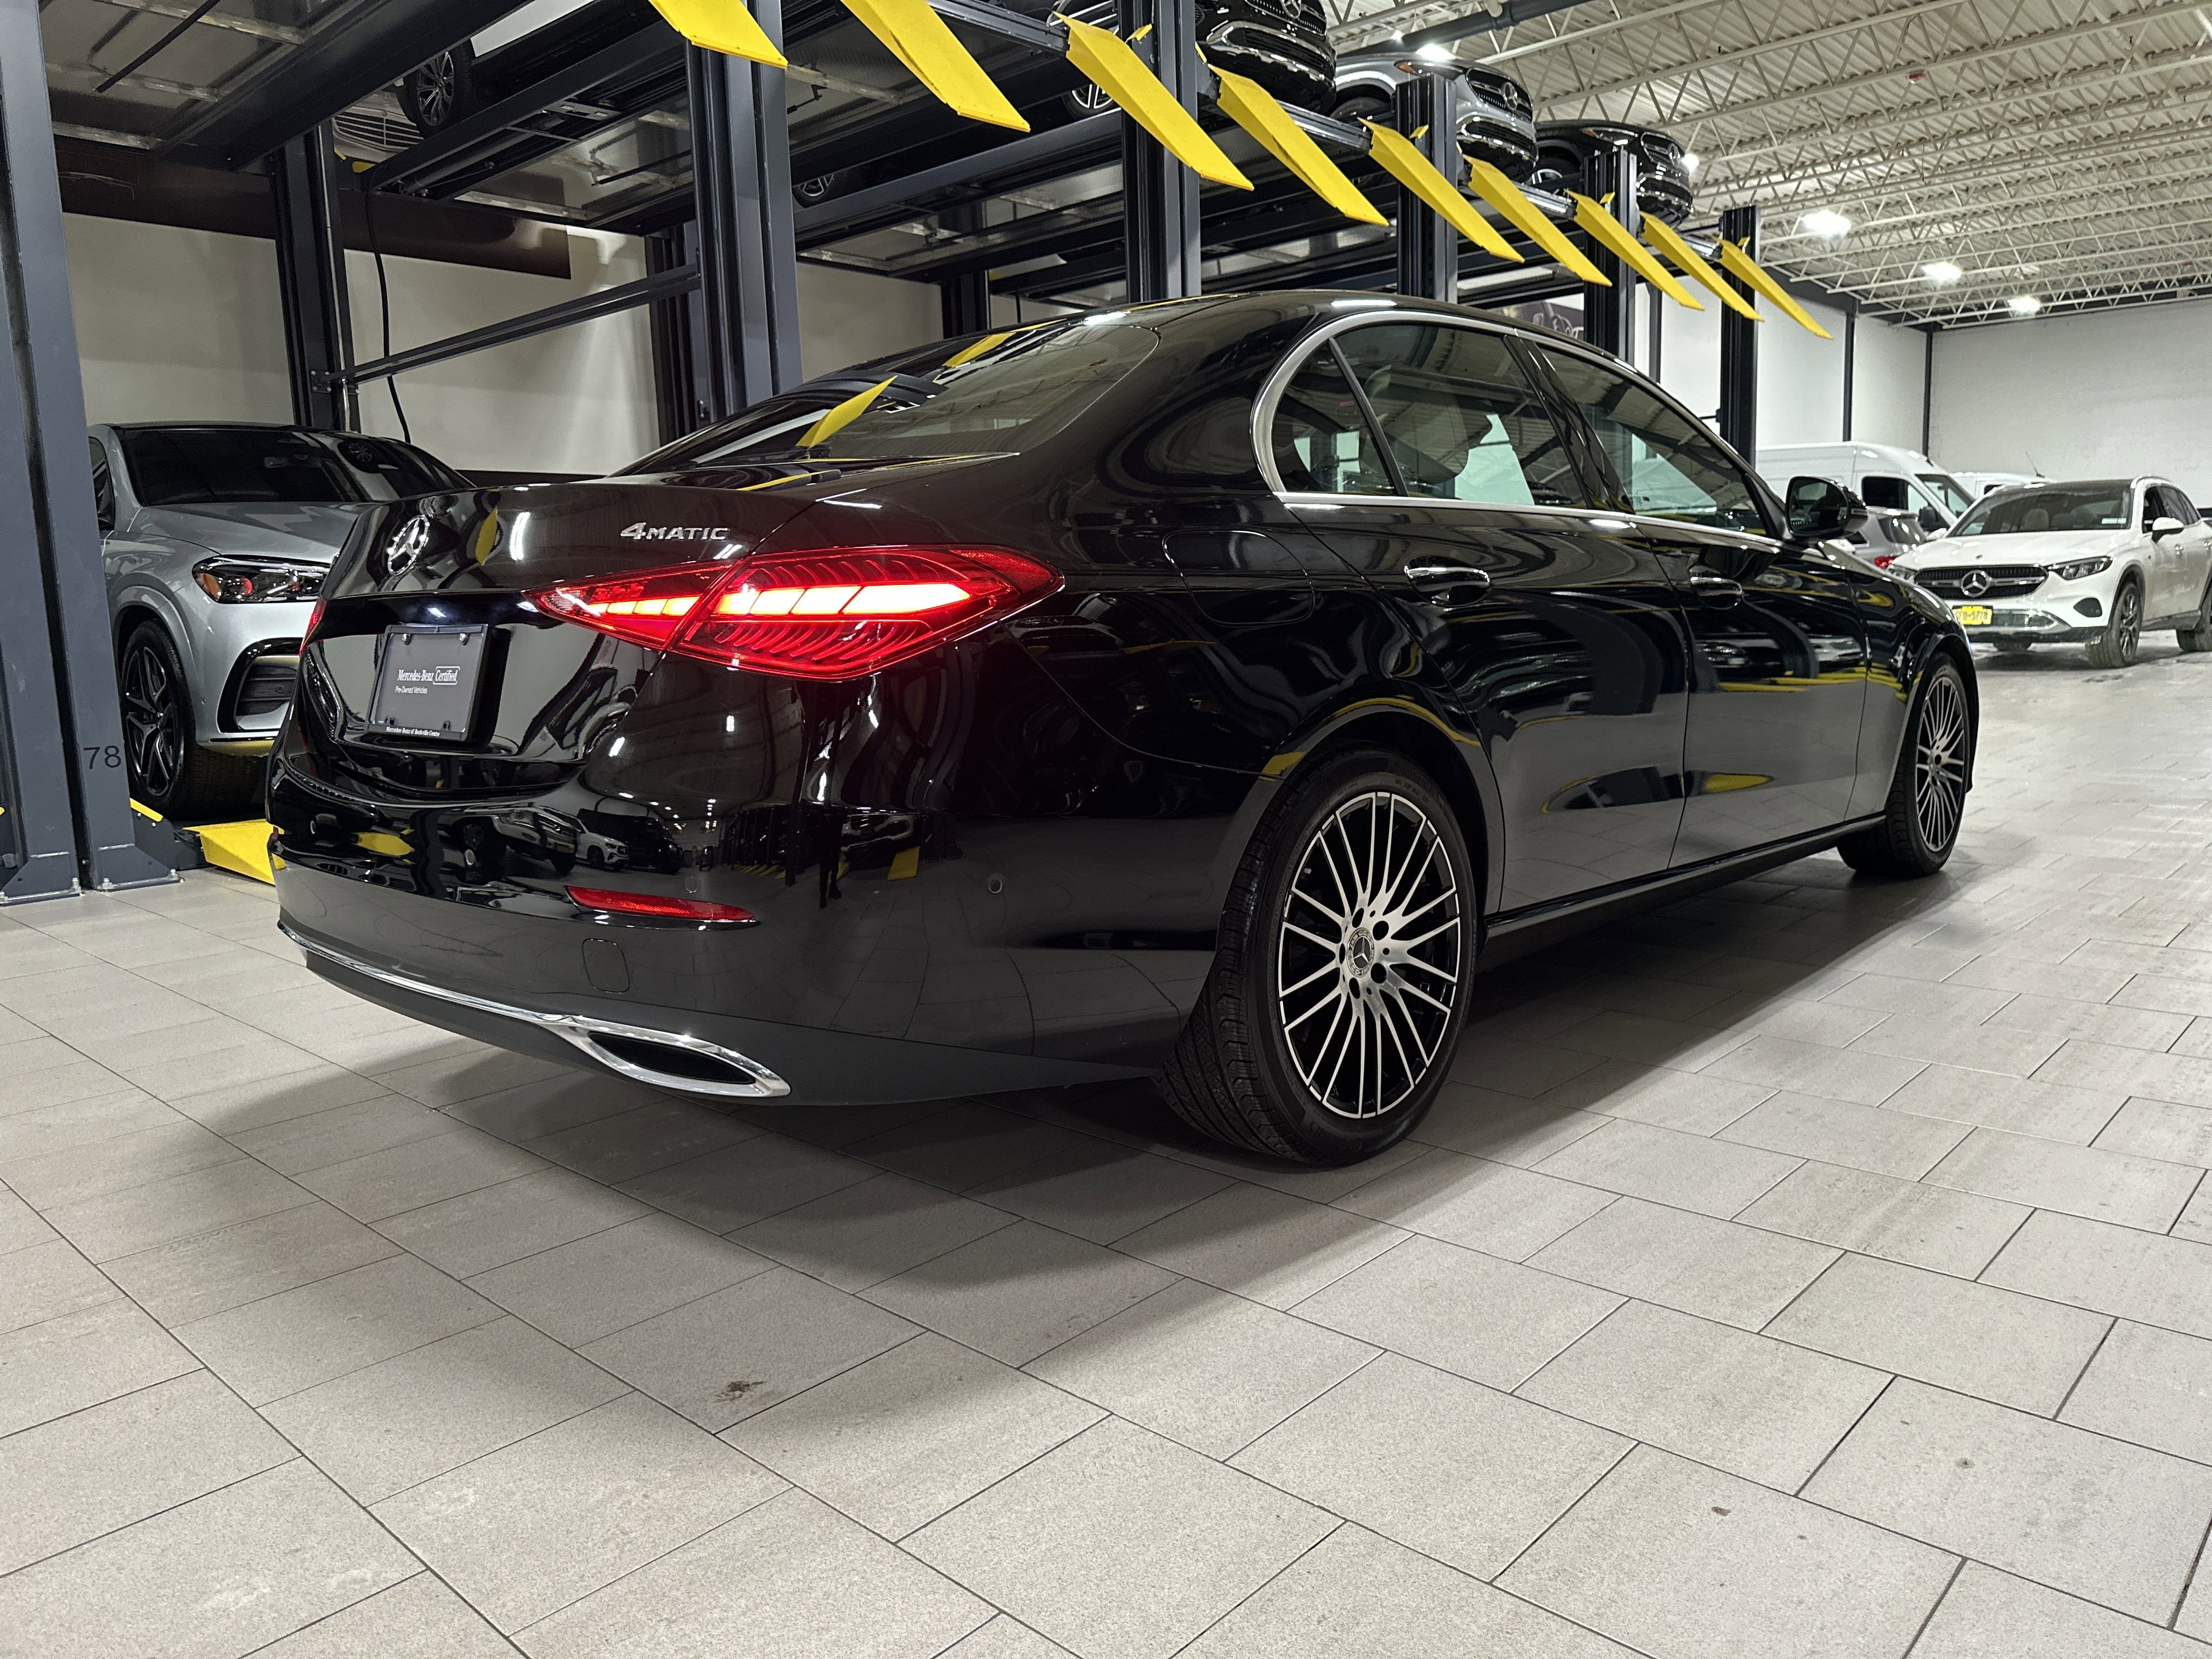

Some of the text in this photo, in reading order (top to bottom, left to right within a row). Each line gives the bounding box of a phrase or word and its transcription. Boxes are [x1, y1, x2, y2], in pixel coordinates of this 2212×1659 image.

[620, 522, 730, 540] 4MATIC
[397, 669, 458, 681] Mercedes-Benz Certified
[83, 744, 122, 770] 78
